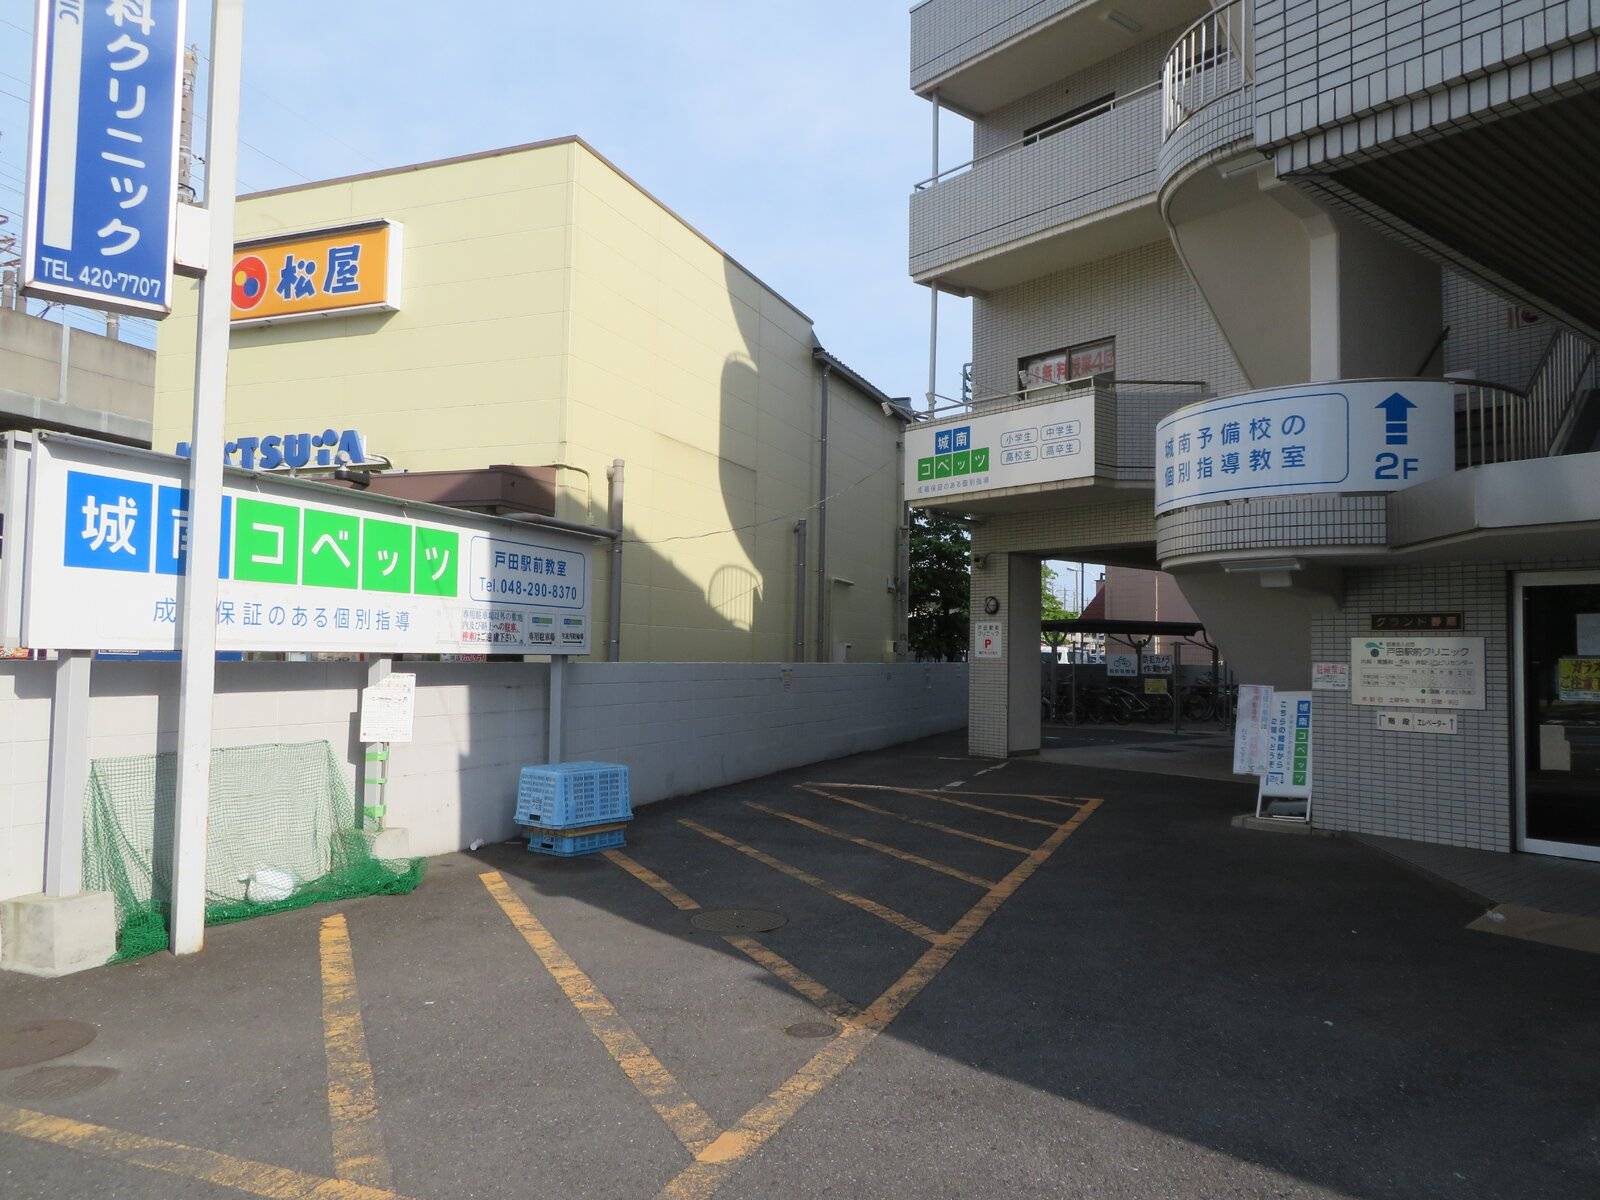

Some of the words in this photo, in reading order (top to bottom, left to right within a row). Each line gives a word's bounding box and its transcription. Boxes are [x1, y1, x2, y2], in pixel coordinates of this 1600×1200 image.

[41, 257, 73, 282] TEL
[79, 265, 162, 299] 420-7707
[276, 244, 361, 300] 松屋
[937, 431, 968, 449] 城南
[1006, 432, 1032, 443] 小学生
[1046, 424, 1074, 436] 中学生
[1165, 415, 1306, 458] 城南予備校の
[920, 453, 986, 477] コベッツ
[1165, 445, 1306, 488] 個別指導教室
[1375, 453, 1419, 480] 2F
[494, 551, 567, 577] 戸田駅前教室
[153, 597, 410, 632] 成保証のある個別指導
